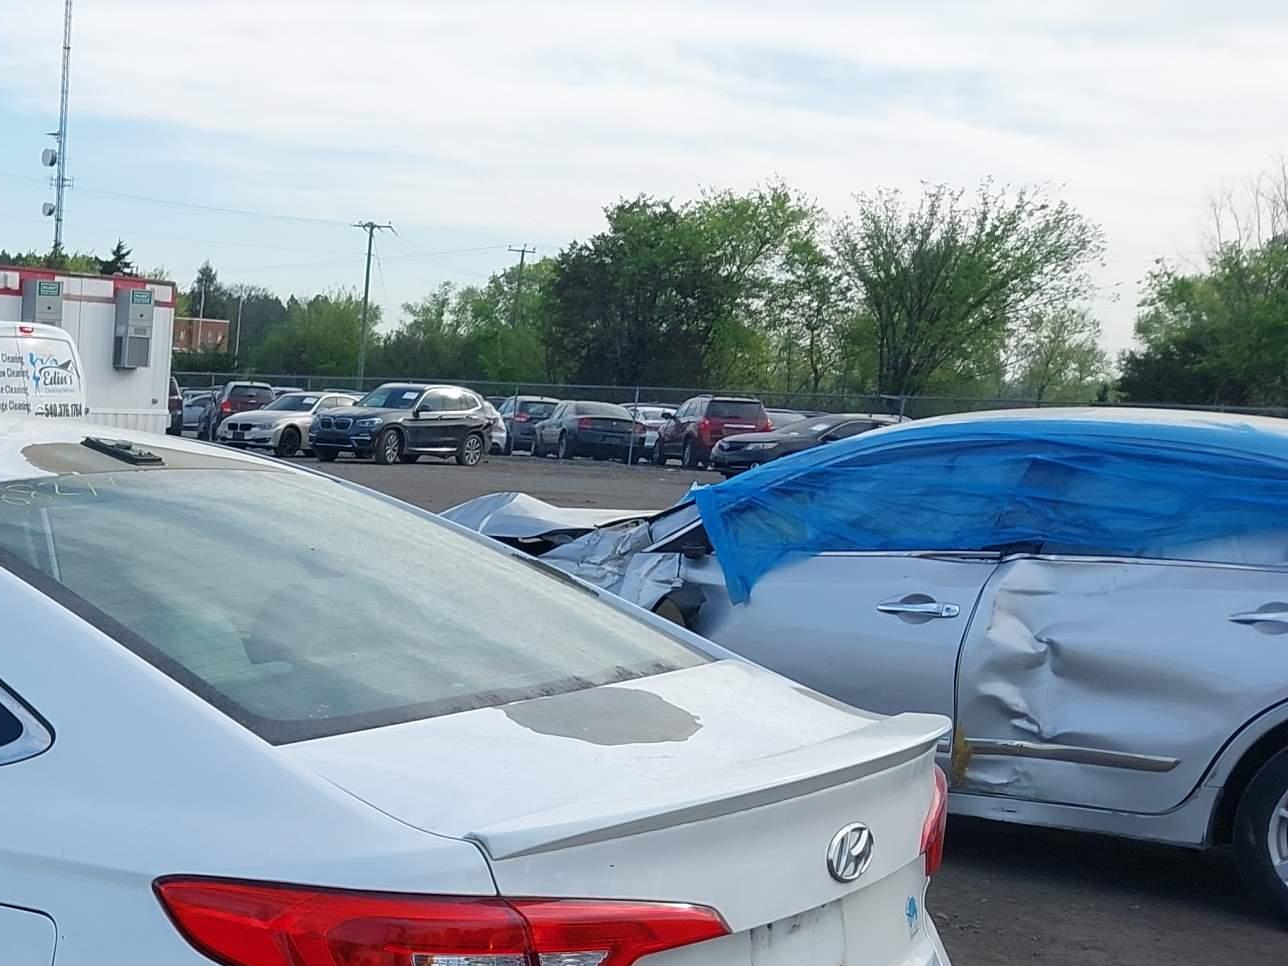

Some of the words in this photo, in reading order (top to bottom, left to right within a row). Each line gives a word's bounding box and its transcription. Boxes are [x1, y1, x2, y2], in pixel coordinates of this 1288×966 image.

[1, 352, 24, 365] Cleaning
[7, 367, 29, 380] Cleaning
[43, 370, 73, 386] Edin's
[4, 384, 29, 396] Cleaning
[8, 400, 31, 414] Cleaning
